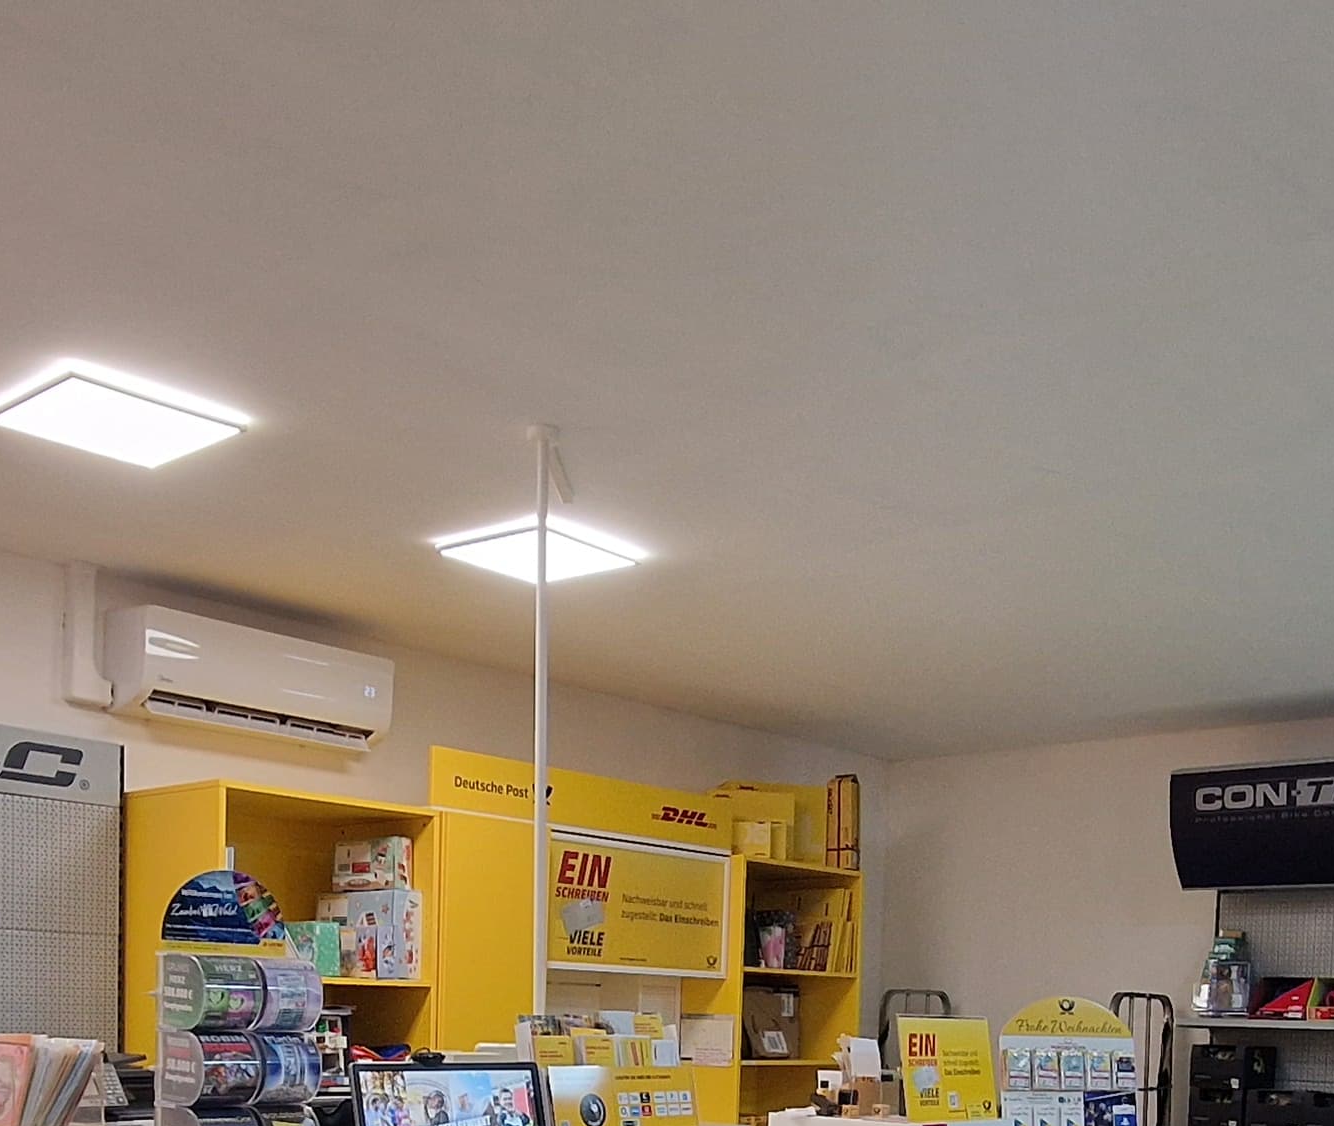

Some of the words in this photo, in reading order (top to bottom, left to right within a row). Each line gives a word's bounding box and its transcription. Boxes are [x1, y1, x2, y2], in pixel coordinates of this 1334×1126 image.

[454, 775, 504, 795] Deutsche
[506, 783, 529, 799] Post
[660, 806, 710, 828] DHL
[1195, 811, 1276, 823] Professional
[1281, 809, 1308, 819] Bike
[557, 850, 612, 889] EIN
[555, 886, 610, 903] SCHREIBEN
[622, 893, 668, 908] Nachweisbar
[669, 898, 683, 909] und
[684, 900, 708, 911] schnell
[658, 912, 673, 923] Das
[674, 914, 719, 927] Einschreiben
[569, 929, 605, 947] VIELE
[566, 946, 602, 957] VORTEILE
[1015, 1018, 1048, 1033] Frohe
[1050, 1019, 1123, 1034] Weihnachten
[908, 1033, 936, 1057] EIN
